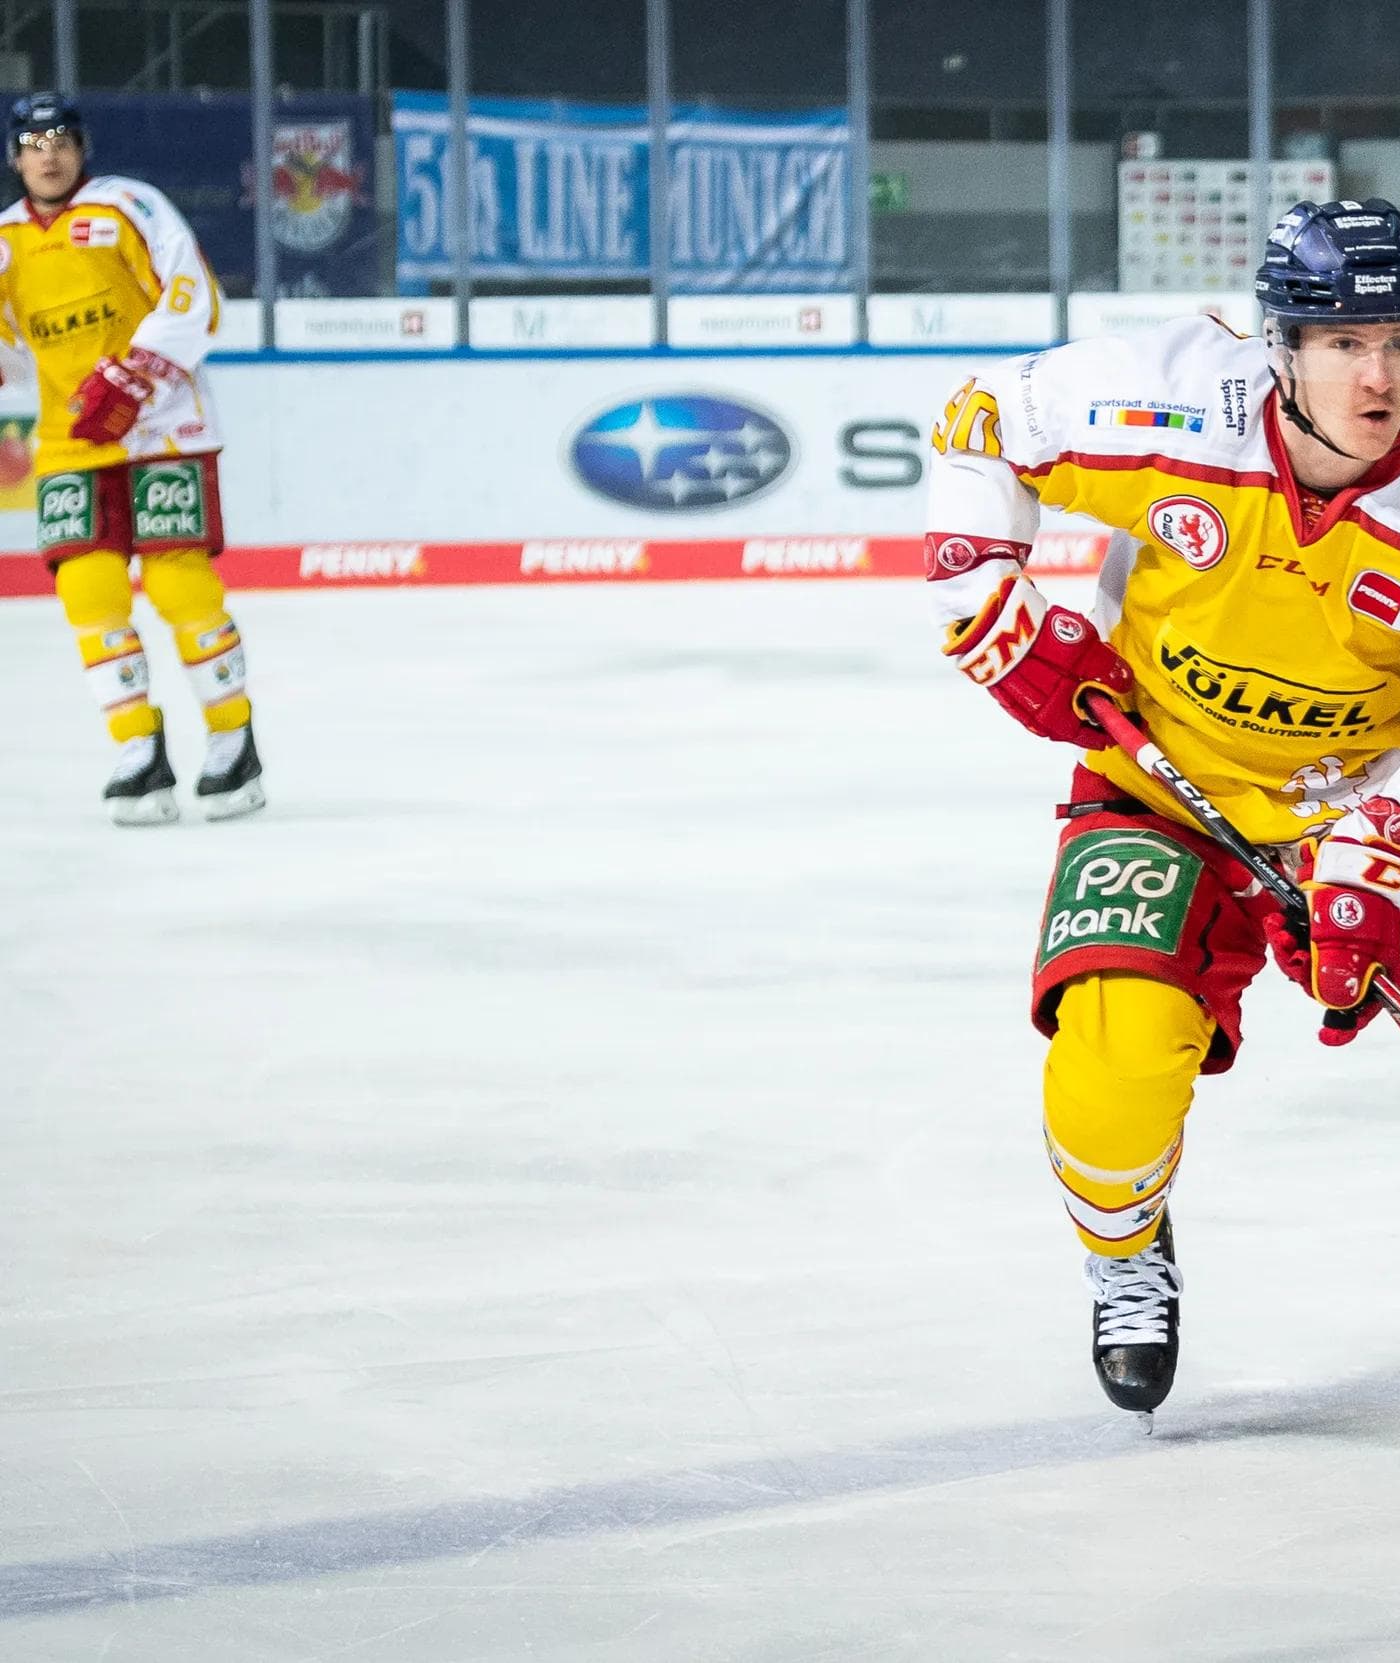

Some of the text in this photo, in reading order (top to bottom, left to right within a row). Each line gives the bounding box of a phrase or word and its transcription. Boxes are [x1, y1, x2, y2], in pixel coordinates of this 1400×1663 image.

[514, 140, 636, 262] LINE
[169, 275, 196, 315] 6
[1354, 275, 1397, 284] Effecten
[1354, 283, 1393, 294] Spiegel
[1089, 398, 1142, 409] sportstadt
[1219, 378, 1236, 429] Spiegel
[1234, 378, 1247, 437] Effecten
[1161, 644, 1371, 728] VÖLKEL
[1171, 678, 1322, 739] THREADING SOLUTIONS
[1153, 757, 1224, 820] CCM
[1075, 857, 1181, 900] psd
[1046, 902, 1165, 951] Bank
